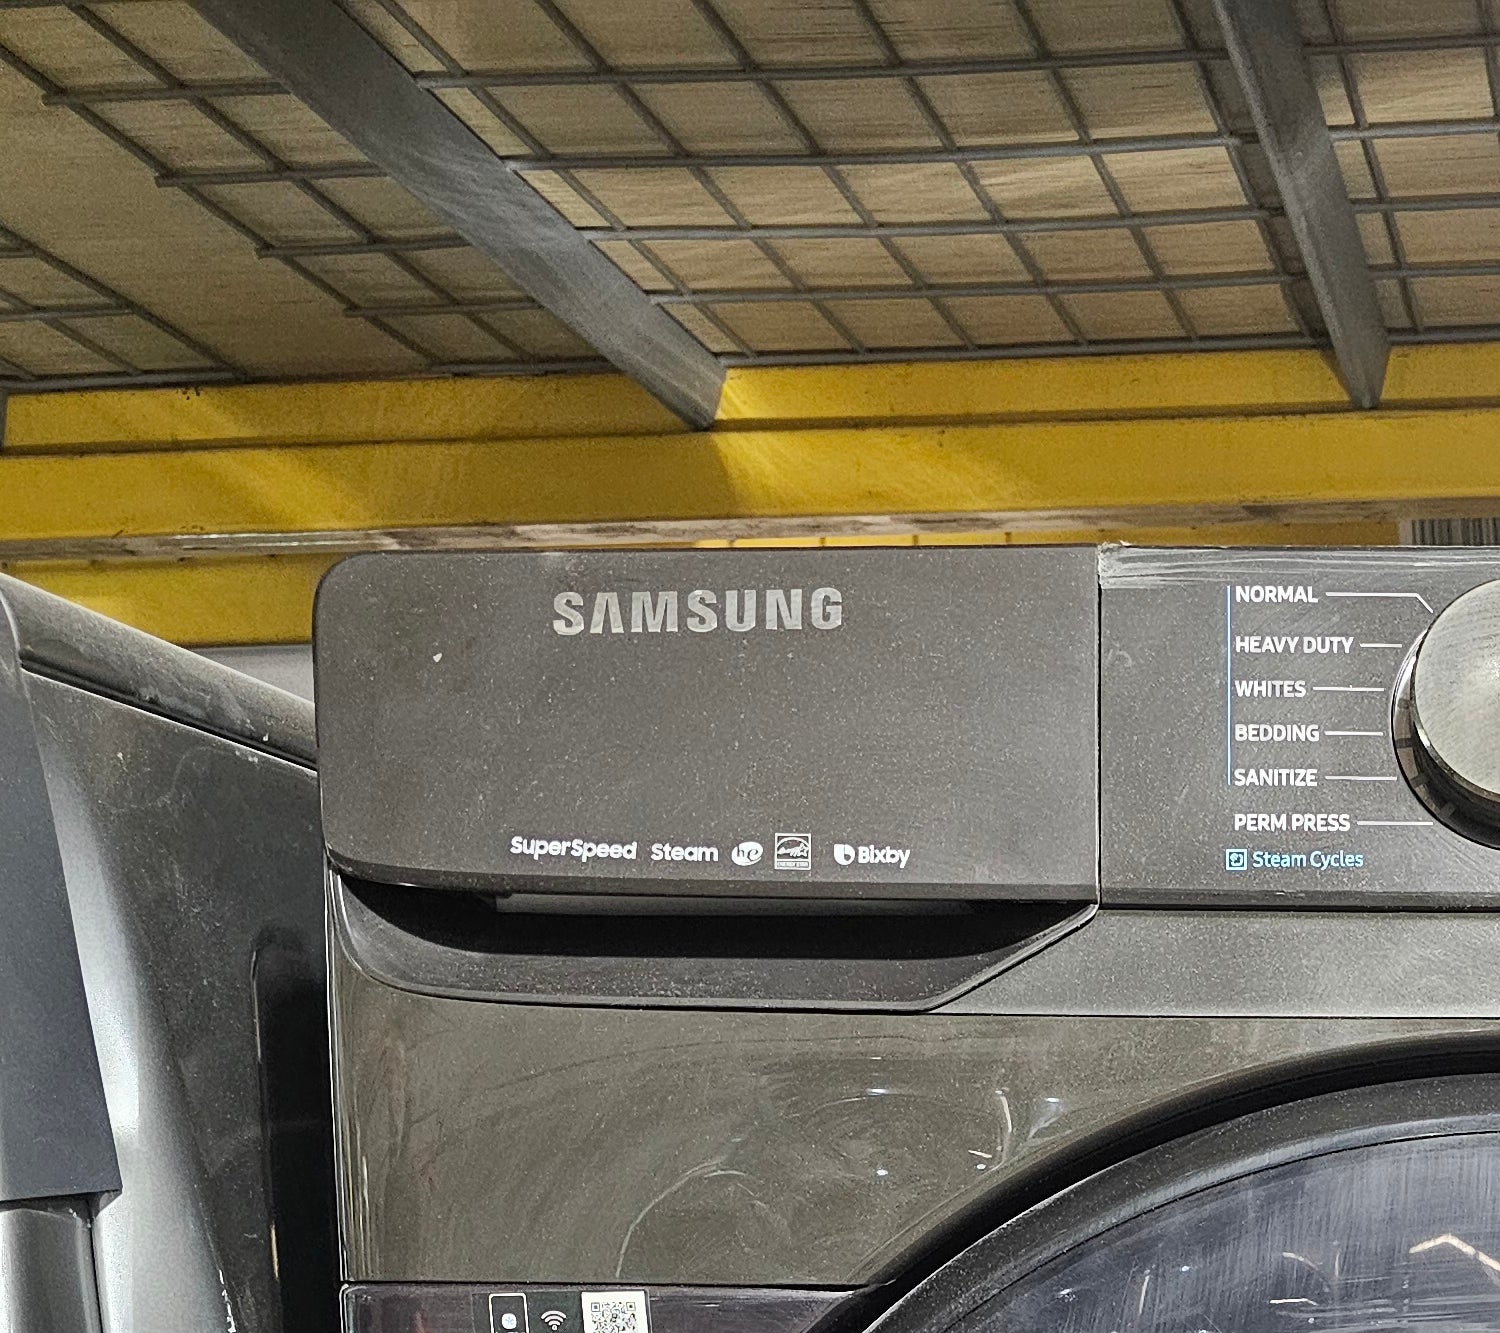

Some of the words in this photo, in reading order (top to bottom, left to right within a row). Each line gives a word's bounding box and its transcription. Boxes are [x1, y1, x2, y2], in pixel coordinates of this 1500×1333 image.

[1235, 586, 1319, 603] NORMAL
[552, 587, 843, 636] SAMSUNG
[1235, 637, 1299, 654] HEAVY
[1302, 636, 1354, 654] DUTY
[1234, 680, 1307, 698] WHITES
[1234, 724, 1319, 742] BEDDING
[1234, 768, 1318, 787] SANITIZE
[1234, 813, 1285, 832] PERM
[1290, 813, 1351, 832] PRESS
[510, 836, 638, 862] SuperSpeed
[650, 843, 719, 862] Steam
[858, 844, 911, 869] Bixby
[1252, 850, 1307, 868] Steam
[1309, 850, 1364, 870] Cycles
